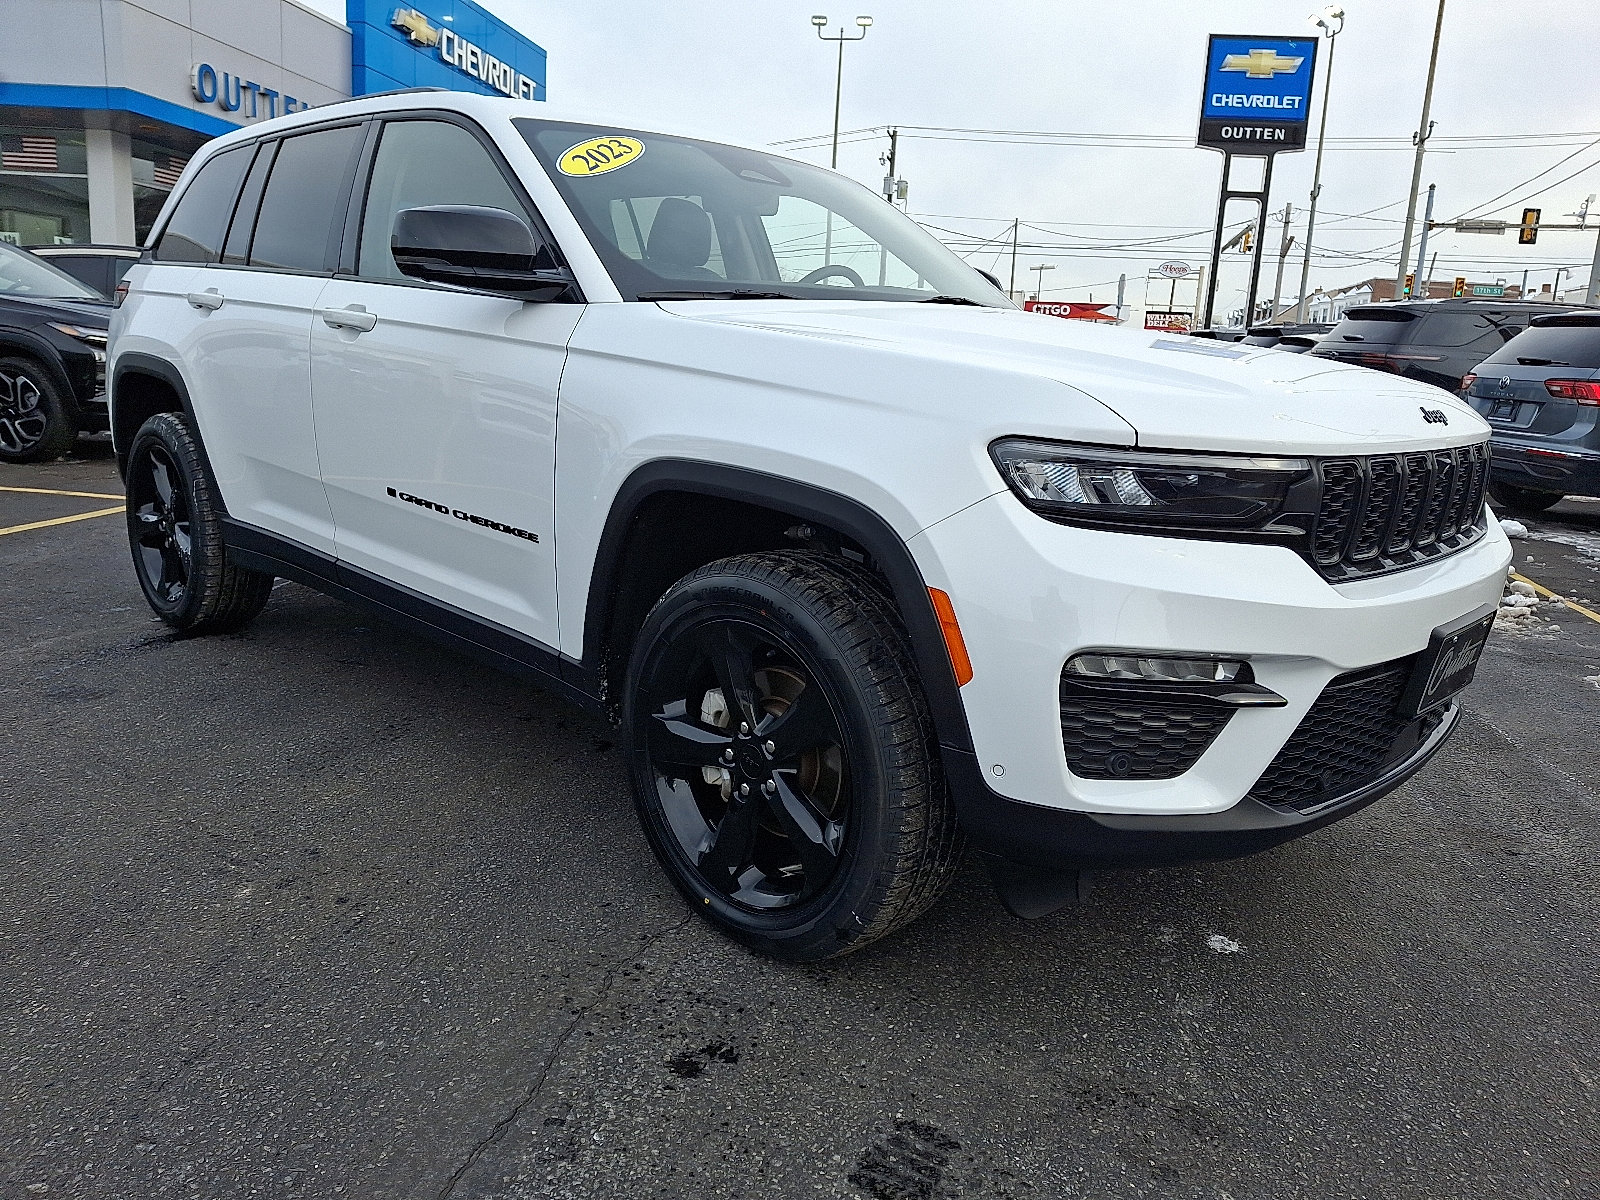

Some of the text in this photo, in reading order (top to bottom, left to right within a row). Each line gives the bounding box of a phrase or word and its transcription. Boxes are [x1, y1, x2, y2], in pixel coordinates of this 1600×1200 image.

[440, 27, 537, 101] CHEVROLET
[192, 62, 312, 119] OUTTE
[1211, 93, 1303, 109] CHEVROLET
[1221, 126, 1286, 141] OUTTEN
[572, 139, 633, 172] 2023
[1032, 304, 1071, 316] CITGO
[1146, 320, 1169, 328] DELI
[1419, 406, 1449, 426] Jeep
[399, 492, 540, 544] GRAND CHEROKEE
